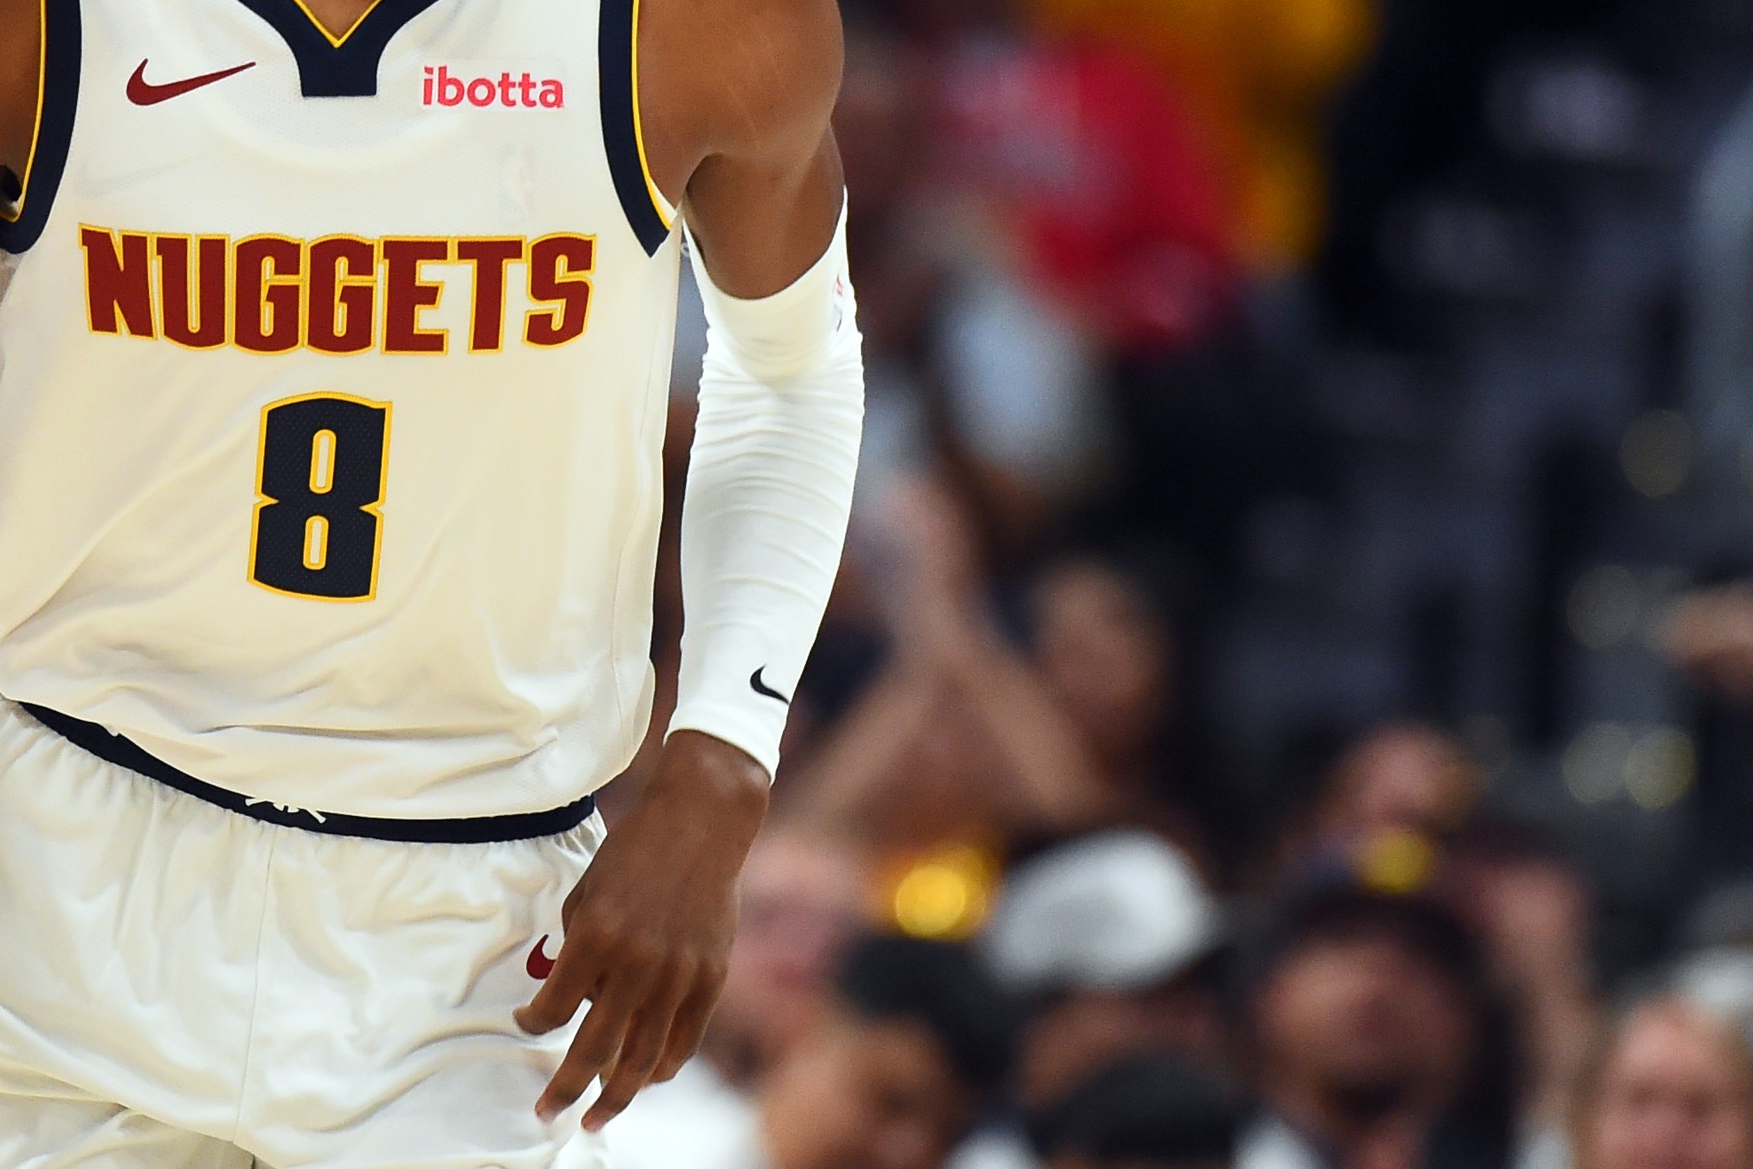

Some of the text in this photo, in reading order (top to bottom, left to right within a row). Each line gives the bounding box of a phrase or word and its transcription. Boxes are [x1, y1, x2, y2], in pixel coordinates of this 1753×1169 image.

[422, 65, 565, 110] ibotta
[78, 222, 597, 357] NUGGETS
[246, 391, 393, 604] 8
